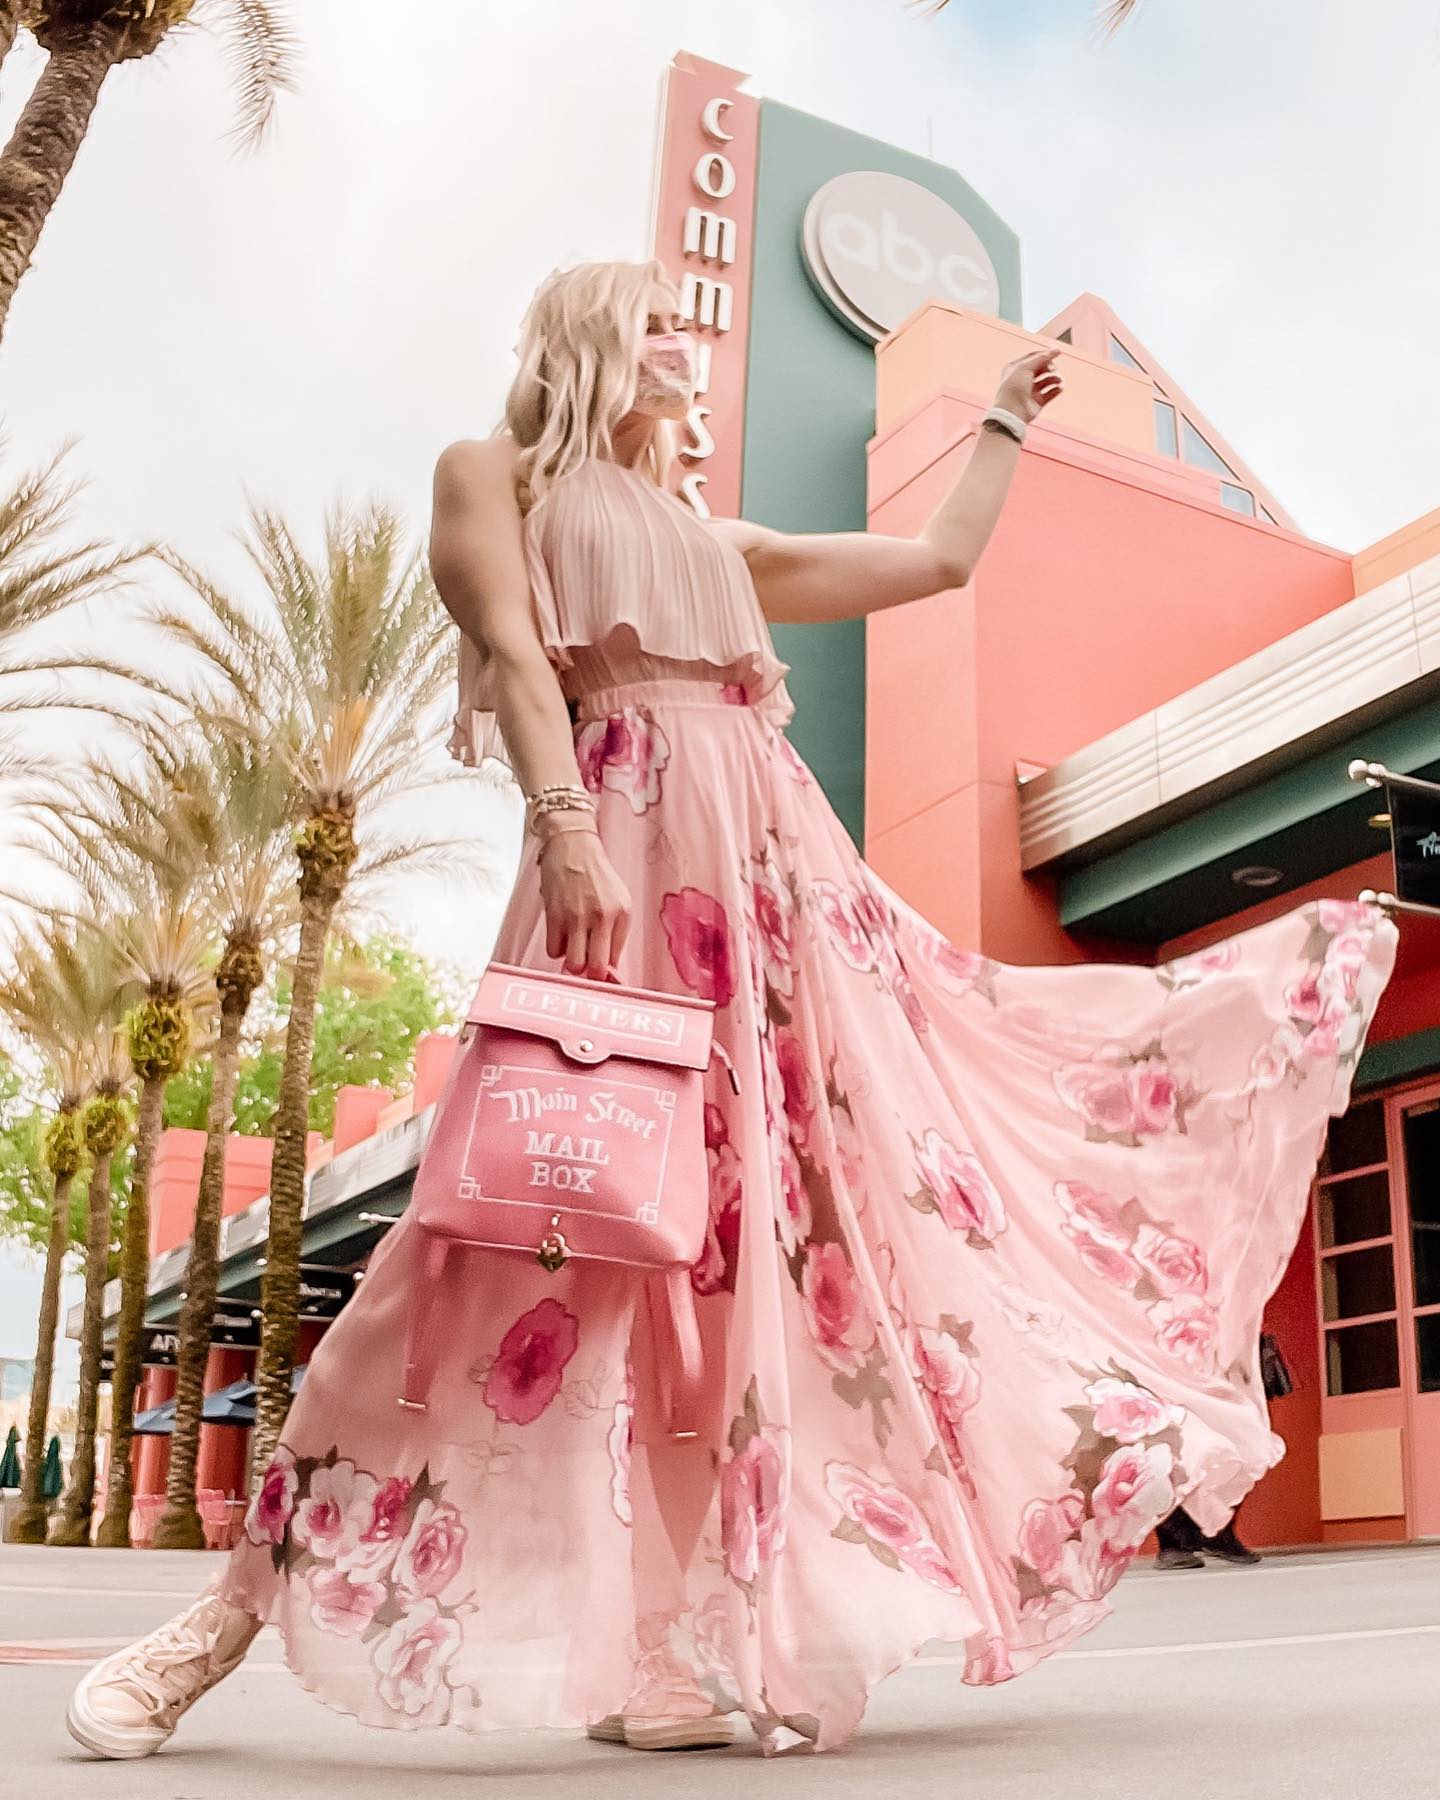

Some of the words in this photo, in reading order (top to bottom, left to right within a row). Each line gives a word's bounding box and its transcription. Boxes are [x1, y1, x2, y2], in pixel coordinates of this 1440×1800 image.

[824, 208, 989, 304] abc
[516, 990, 674, 1035] LETTERS
[488, 1086, 578, 1123] Main
[584, 1090, 658, 1140] Street
[523, 1130, 609, 1165] MAIL
[528, 1160, 598, 1194] BOX
